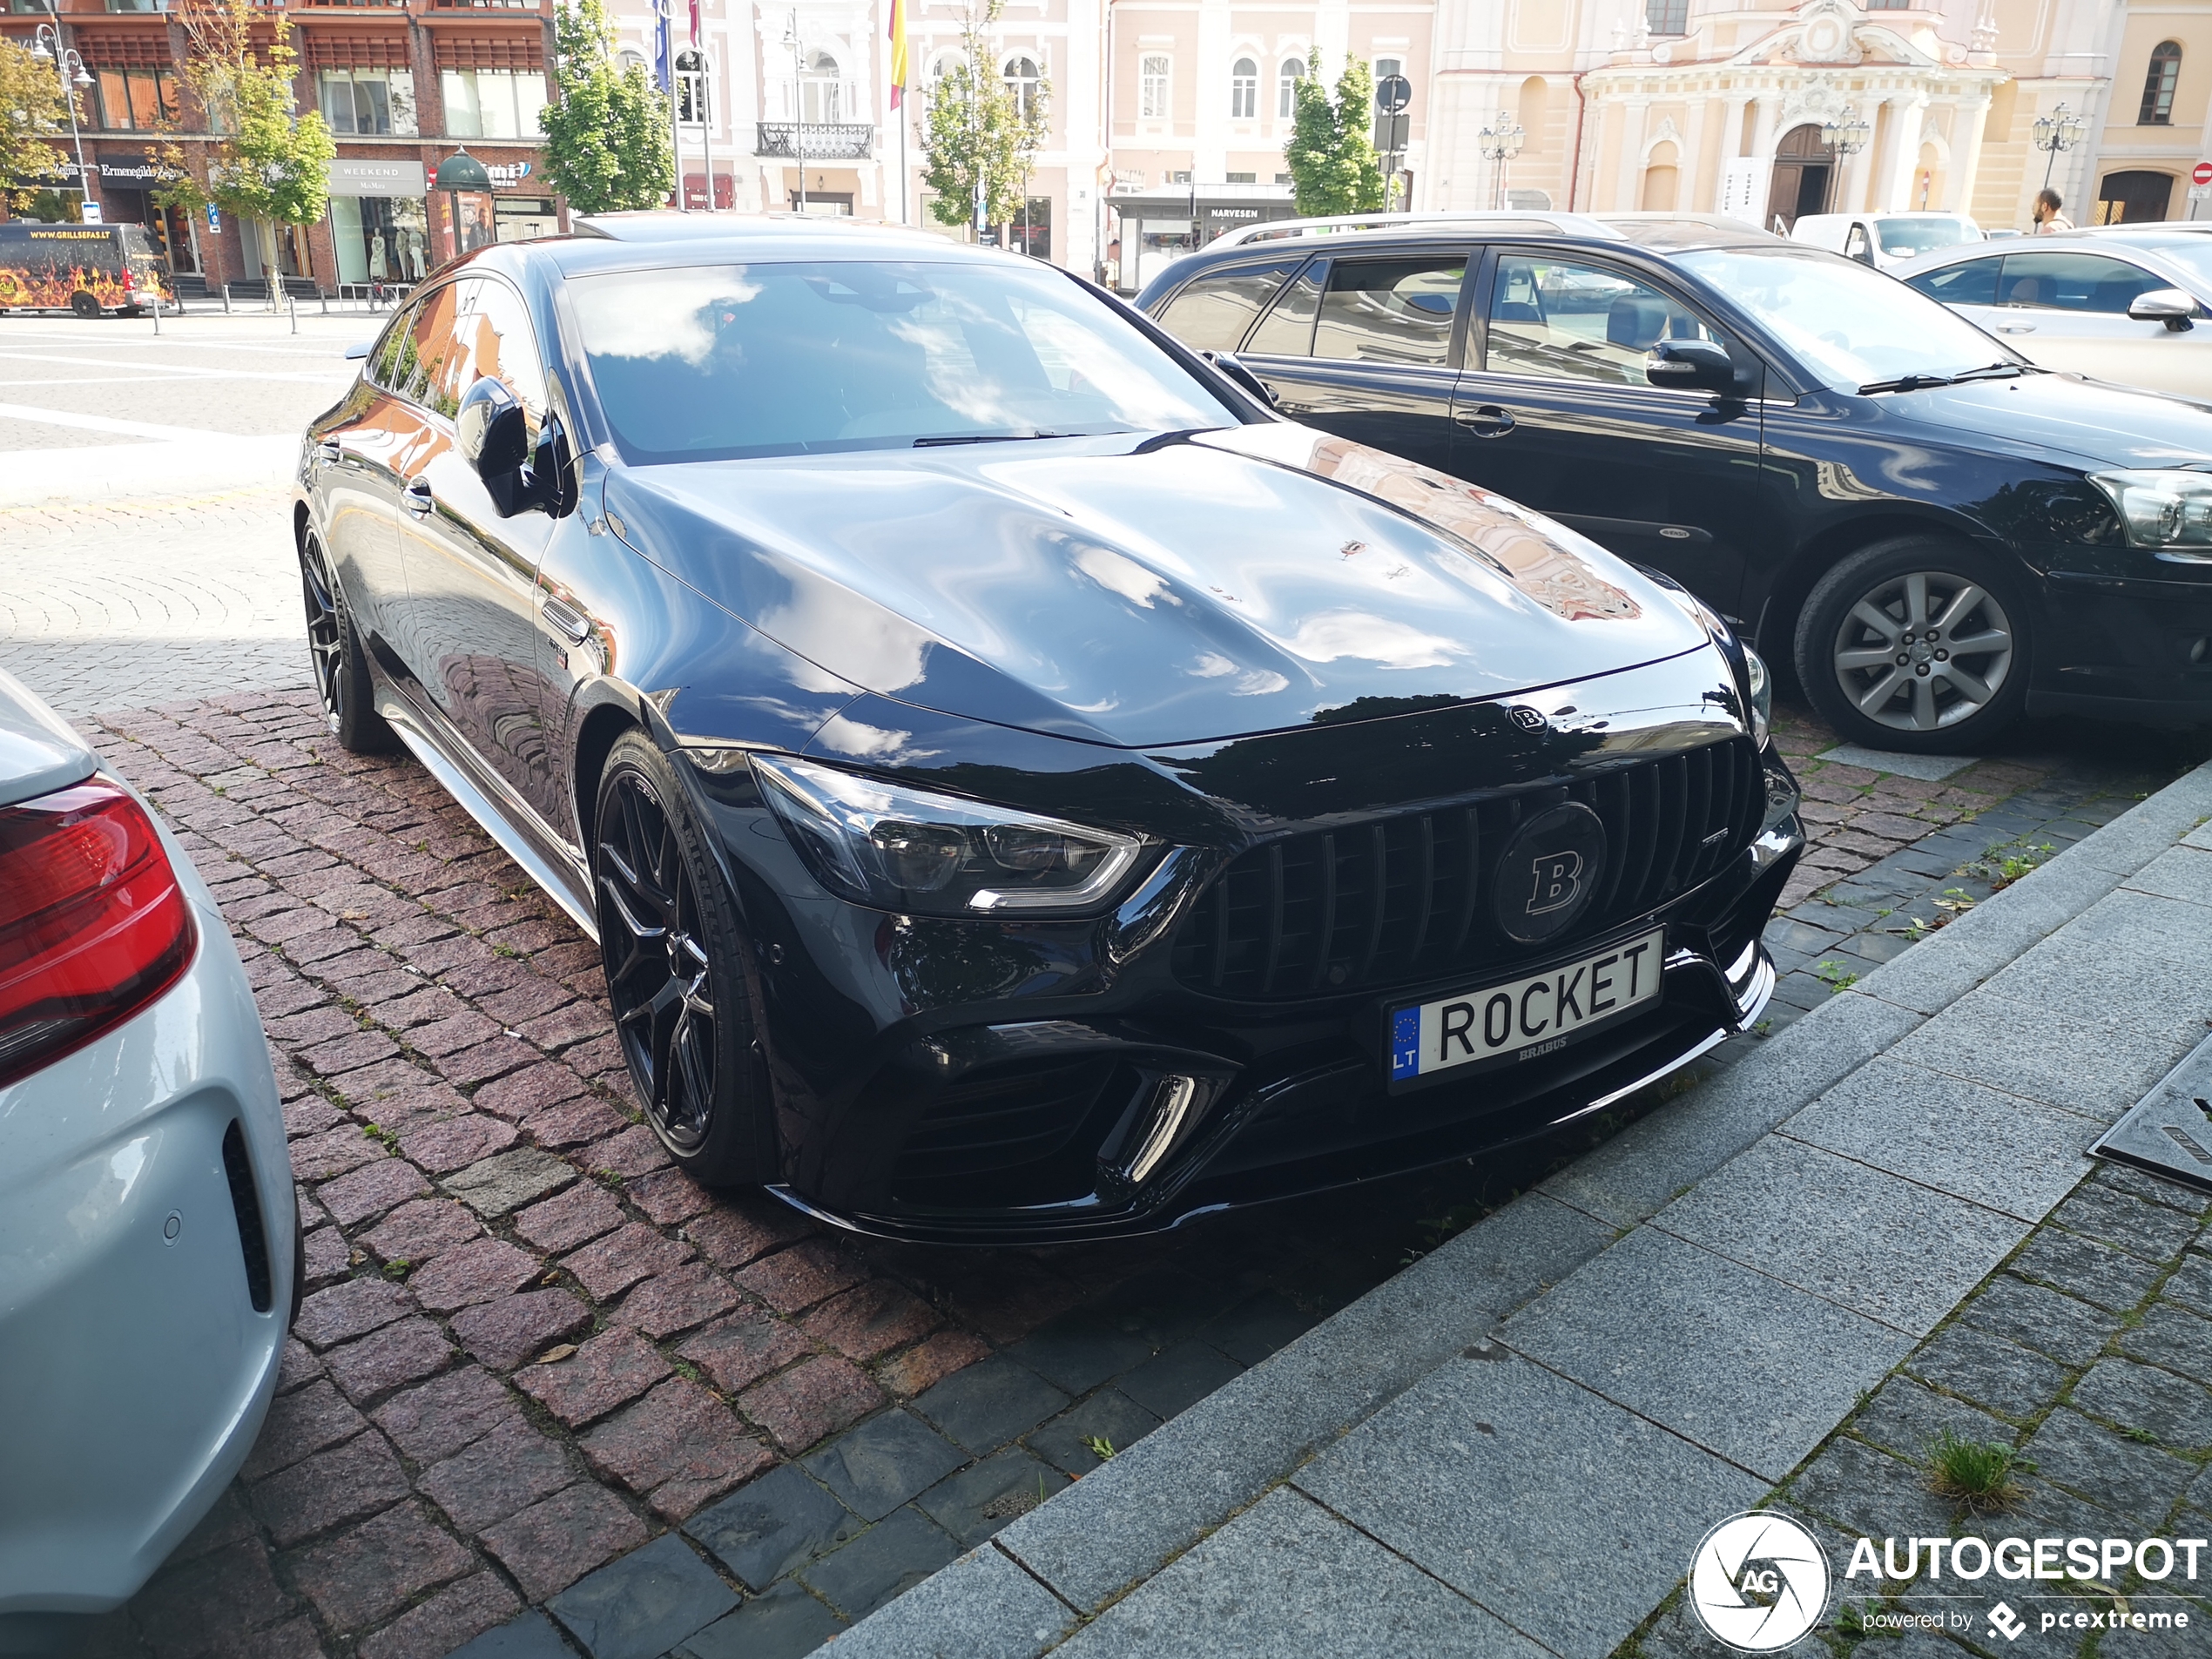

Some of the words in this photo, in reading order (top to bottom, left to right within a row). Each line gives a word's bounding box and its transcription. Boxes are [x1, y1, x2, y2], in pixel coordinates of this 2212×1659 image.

[1211, 208, 1258, 218] NARVESEN
[30, 231, 111, 239] WWW.GRILLSEFAS.LT
[1514, 709, 1545, 728] B
[1526, 850, 1583, 915] B
[684, 825, 725, 968] MICHELIN
[1518, 1035, 1568, 1062] BRABUS
[1393, 1049, 1417, 1070] LT
